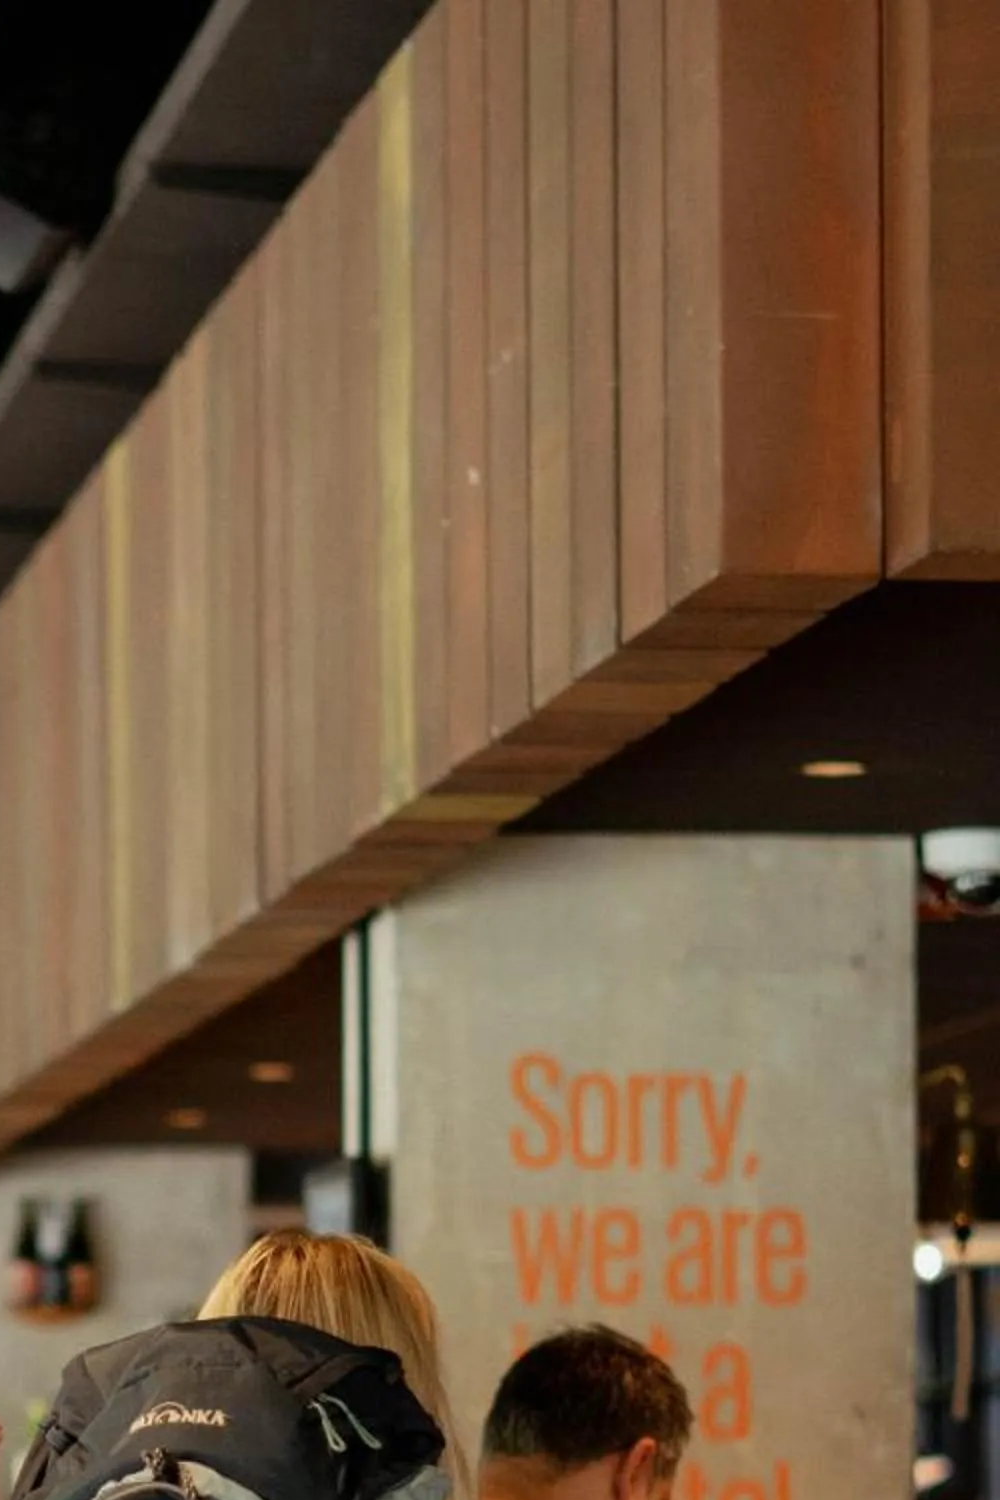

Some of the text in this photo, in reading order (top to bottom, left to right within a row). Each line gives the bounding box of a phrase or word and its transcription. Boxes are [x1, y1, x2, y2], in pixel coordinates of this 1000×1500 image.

[509, 1051, 759, 1184] Sorry,
[510, 1206, 809, 1309] we are
[699, 1342, 755, 1442] a
